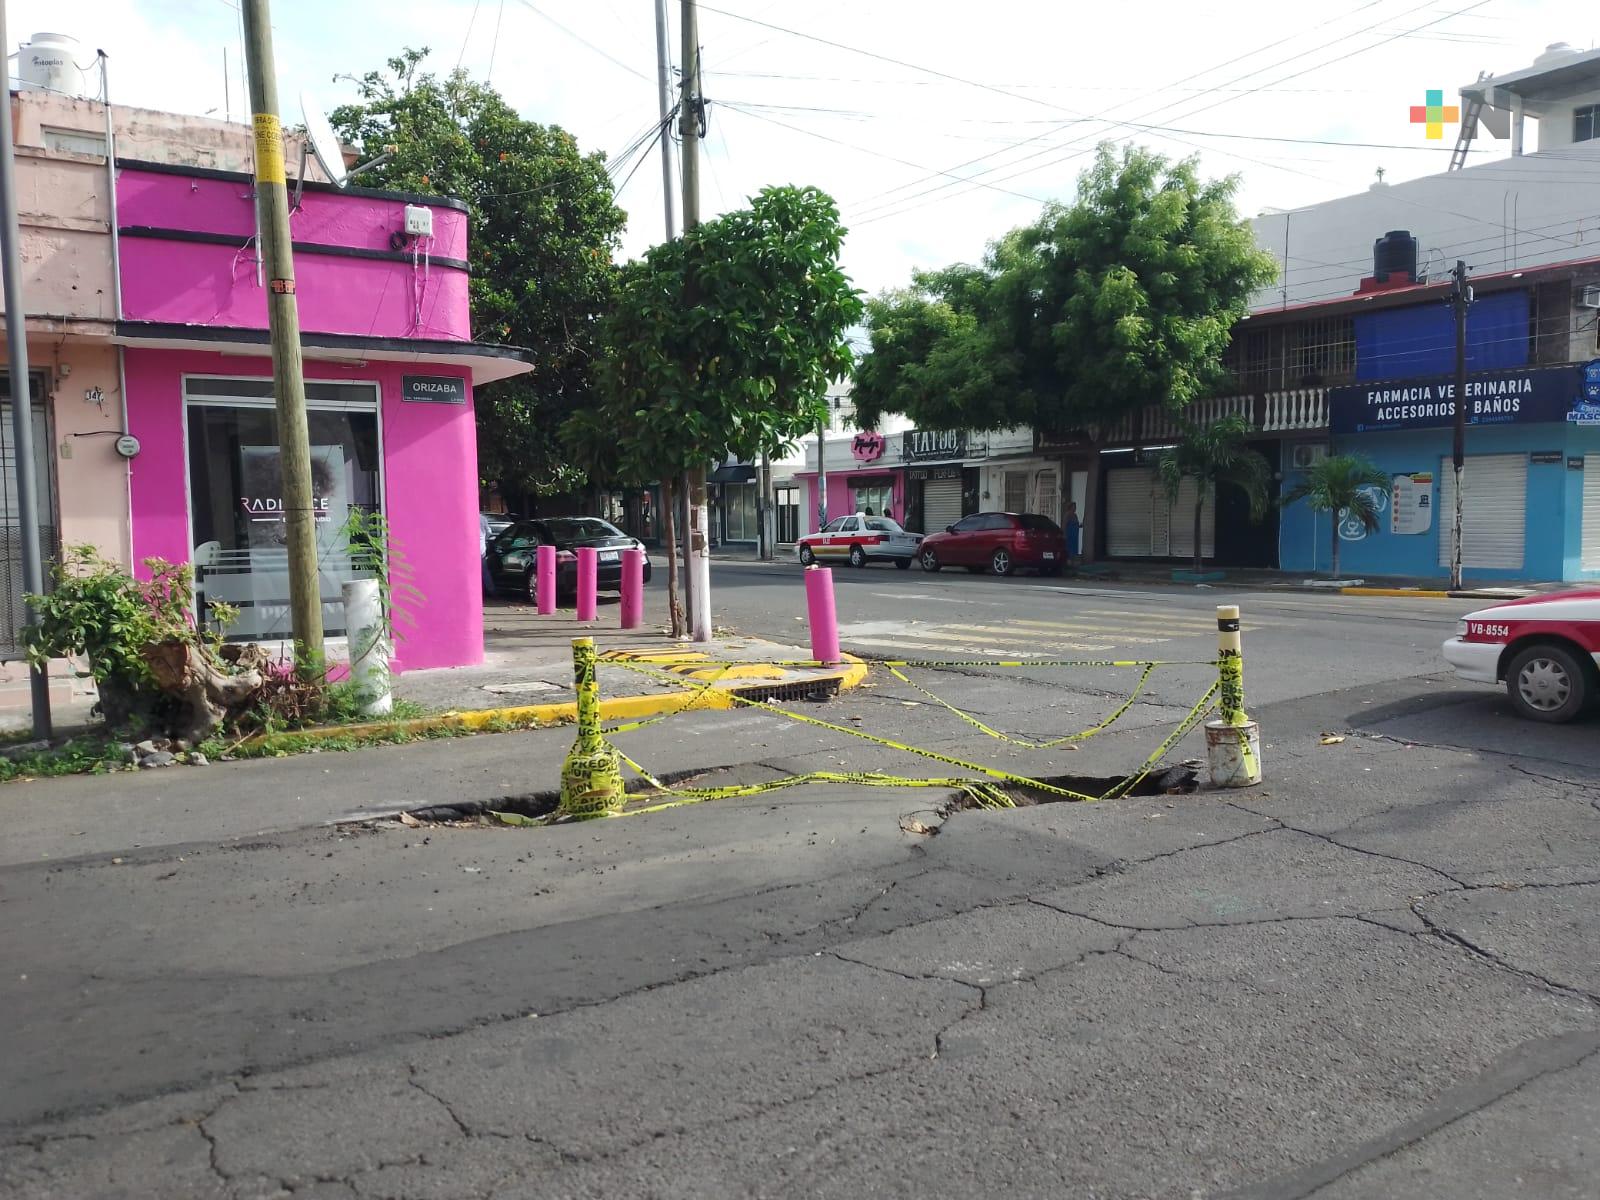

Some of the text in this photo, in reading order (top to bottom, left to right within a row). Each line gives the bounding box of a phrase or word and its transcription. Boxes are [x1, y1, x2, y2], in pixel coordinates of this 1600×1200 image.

[412, 382, 457, 393] ORIZABA
[1367, 378, 1532, 405] FARMACIA VEERINARIA
[1377, 396, 1520, 421] ACCESORIOS BAÑOS
[241, 497, 328, 512] RADIE
